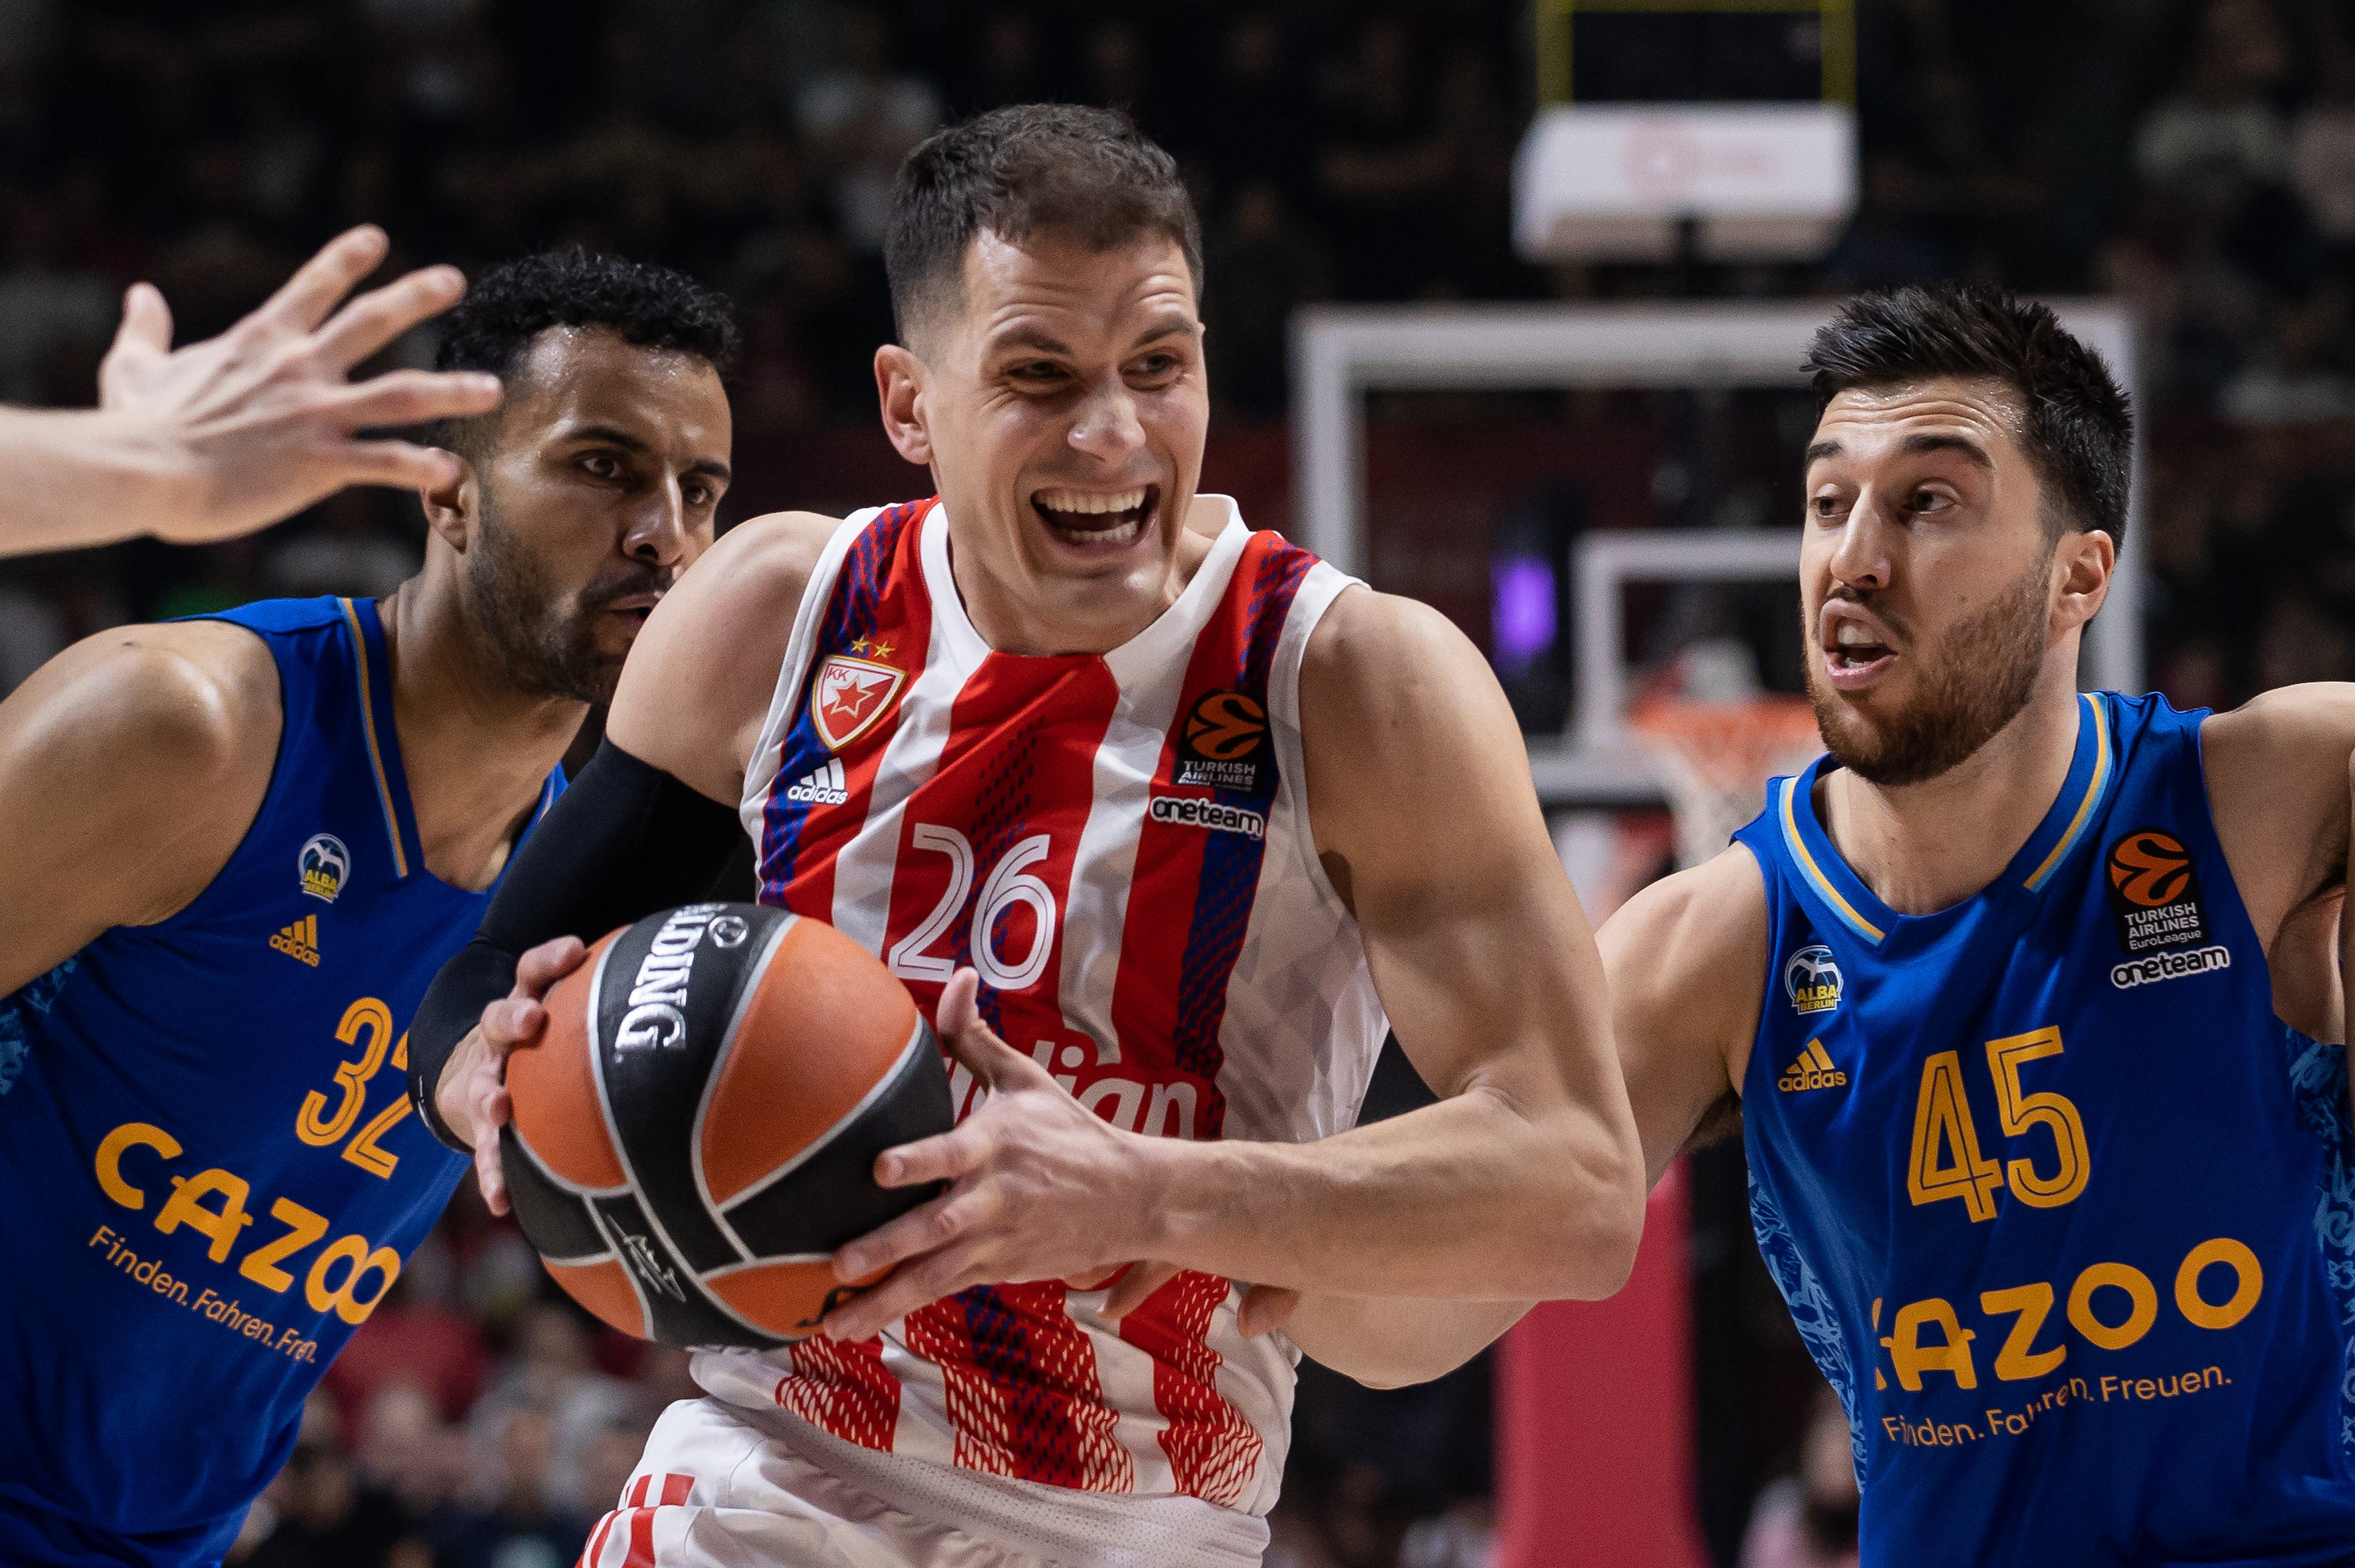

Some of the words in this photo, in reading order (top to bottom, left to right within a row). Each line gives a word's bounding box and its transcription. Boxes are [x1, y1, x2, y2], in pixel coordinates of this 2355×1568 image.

[1178, 771, 1253, 785] AIRLINES
[1184, 760, 1256, 775] TURKISH
[788, 784, 849, 805] adidas
[1151, 797, 1264, 838] oneteam
[888, 822, 1056, 990] 26
[2124, 902, 2197, 925] TURKISH
[2128, 915, 2199, 939] AIRLINES
[2128, 930, 2202, 951] EuroLeague
[269, 933, 321, 967] adidas
[2111, 946, 2231, 988] oneteam
[615, 903, 729, 1050] LDING
[1796, 984, 1838, 1004] ALBA
[1800, 998, 1835, 1012] BERLIN
[296, 997, 412, 1180] 32
[1777, 1069, 1847, 1092] adidas
[1907, 1025, 2090, 1223] 45
[95, 1123, 401, 1325] CAZOO
[88, 1225, 187, 1307] Finden.
[191, 1288, 275, 1347] Fahren.
[2100, 1365, 2232, 1402] Freuen.
